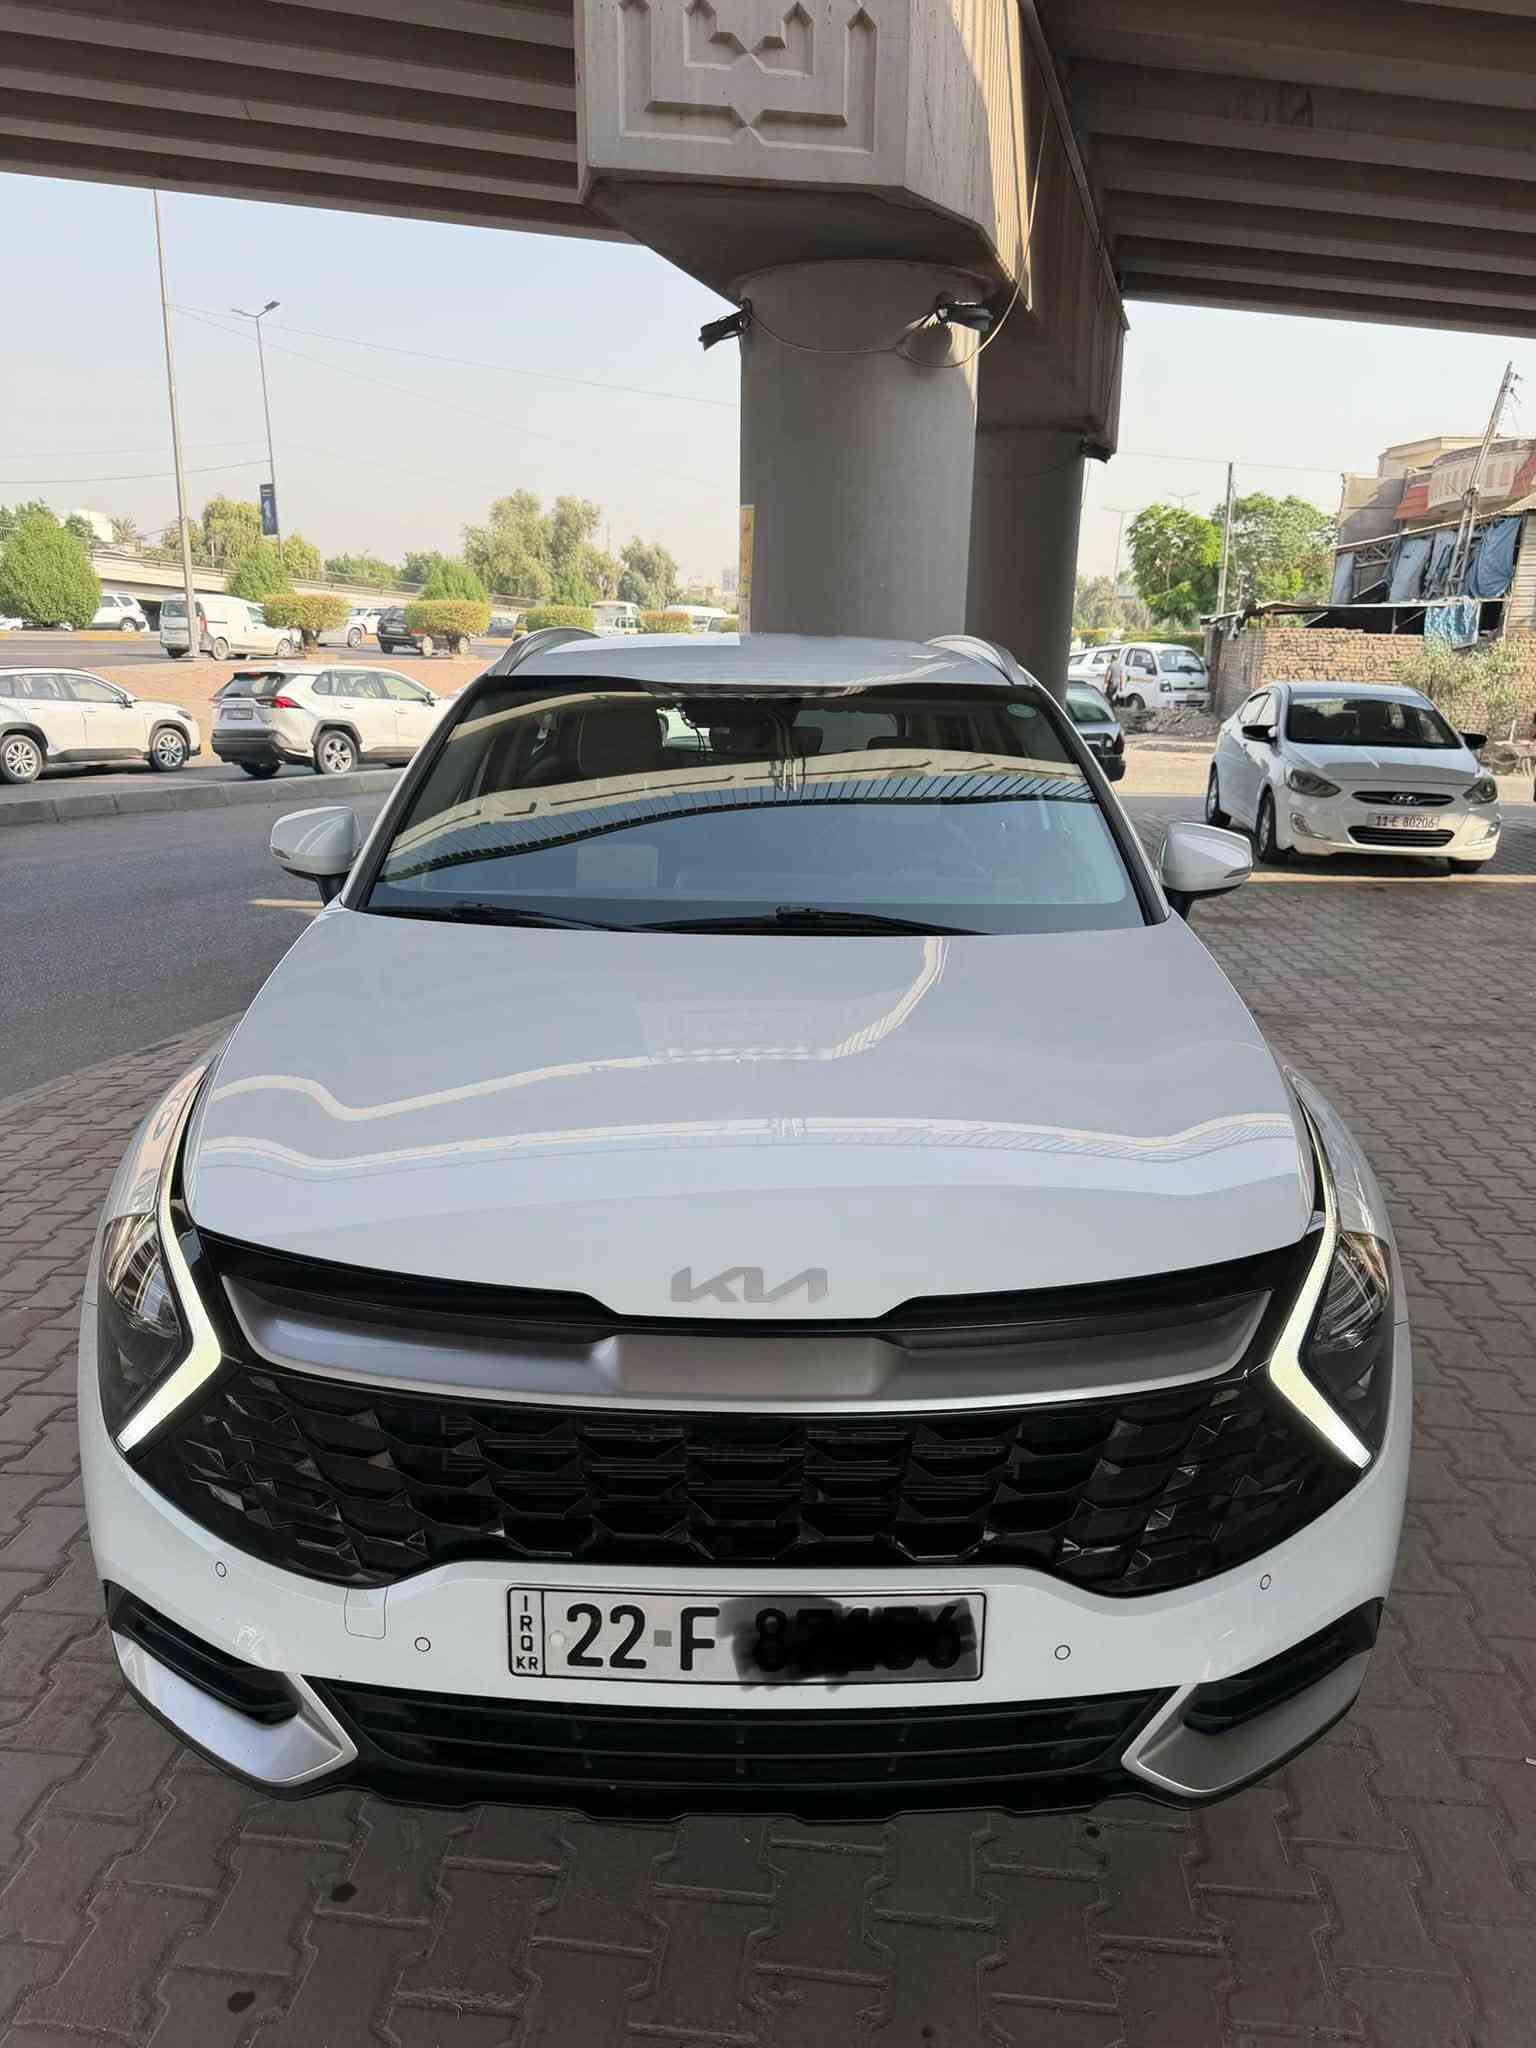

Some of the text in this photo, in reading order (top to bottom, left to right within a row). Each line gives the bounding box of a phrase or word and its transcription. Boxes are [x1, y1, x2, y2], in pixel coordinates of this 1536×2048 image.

[671, 1266, 828, 1303] KIA
[567, 1603, 648, 1670] 22
[680, 1606, 721, 1671] F
[516, 1656, 539, 1670] KR
